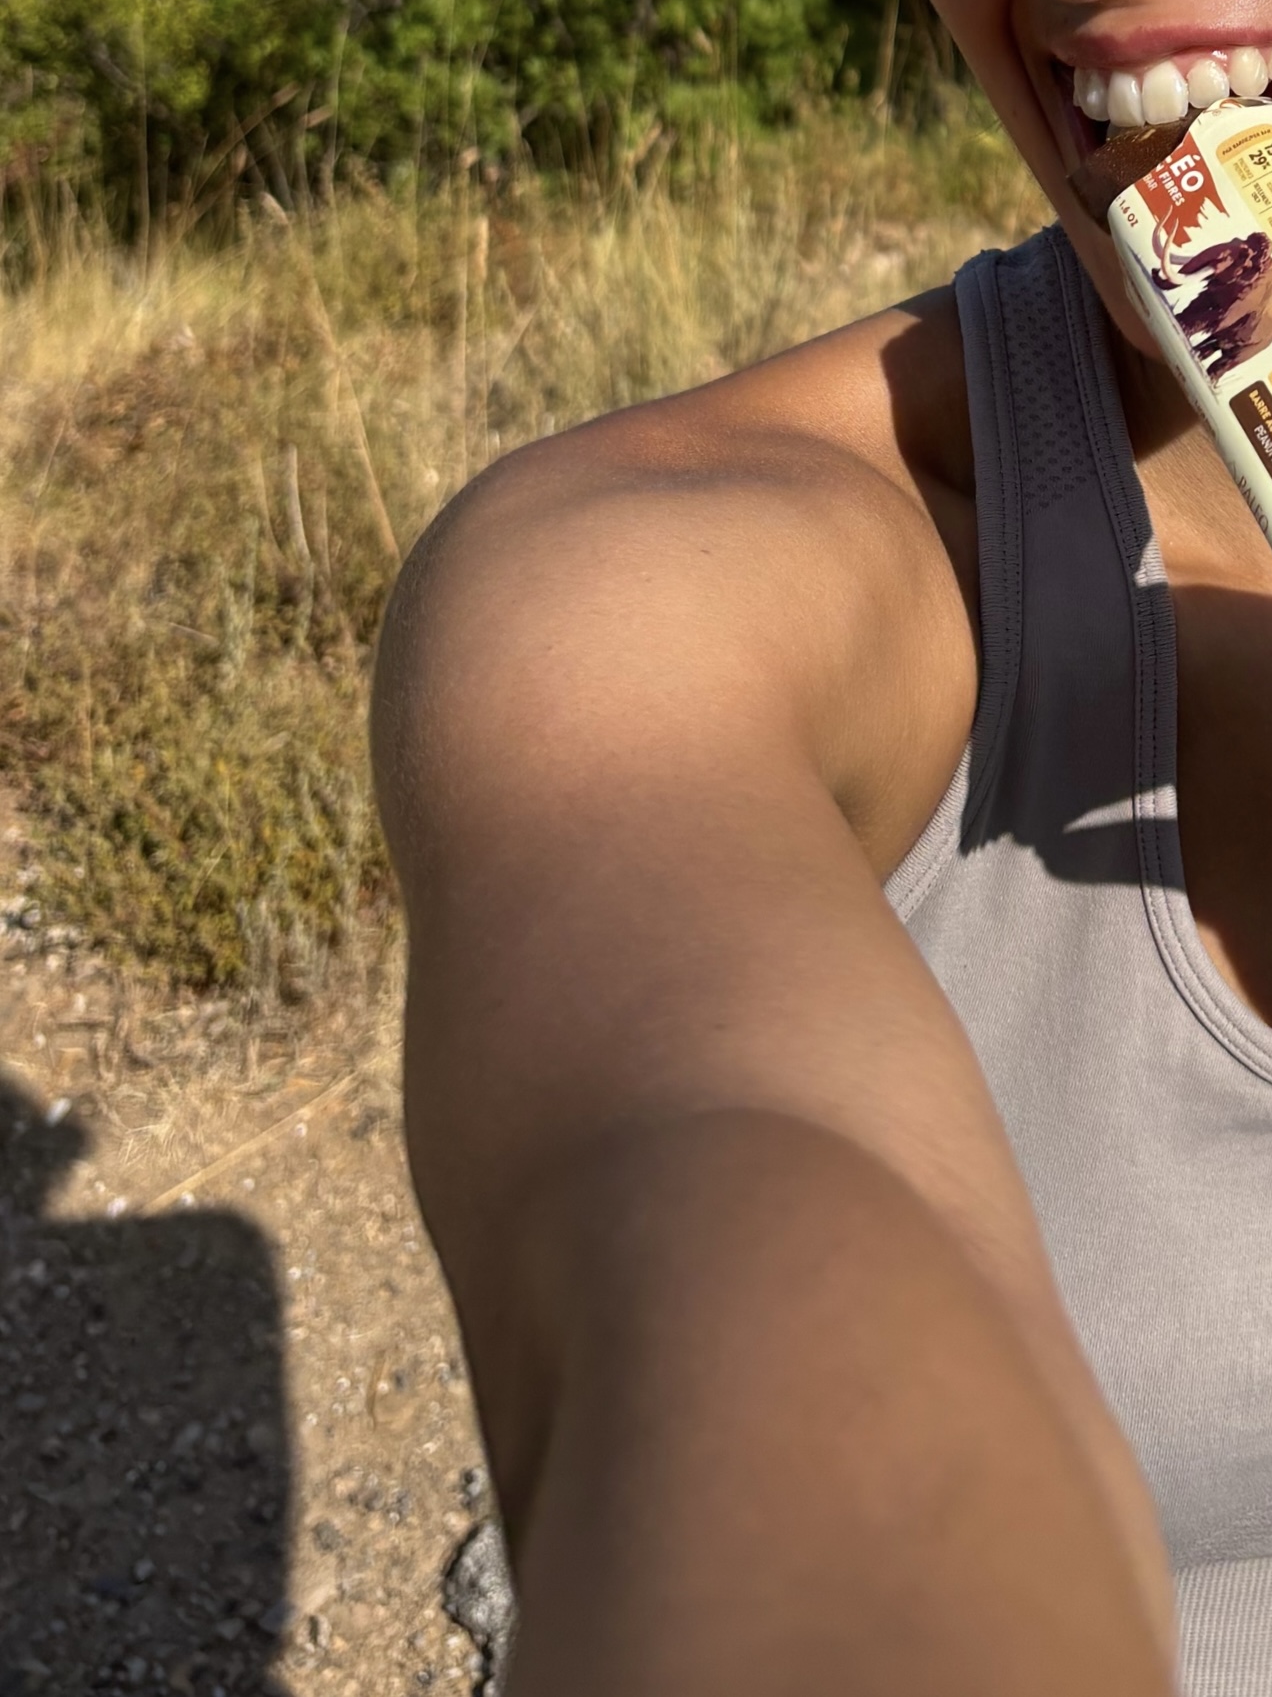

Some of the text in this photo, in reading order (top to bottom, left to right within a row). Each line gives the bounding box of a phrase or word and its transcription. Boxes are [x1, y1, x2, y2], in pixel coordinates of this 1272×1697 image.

[1165, 153, 1205, 193] ÉO
[1247, 147, 1271, 173] 29%
[1157, 170, 1186, 207] FIBRES
[1116, 198, 1139, 228] 1.6 OZ
[1246, 388, 1272, 421] BARRE
